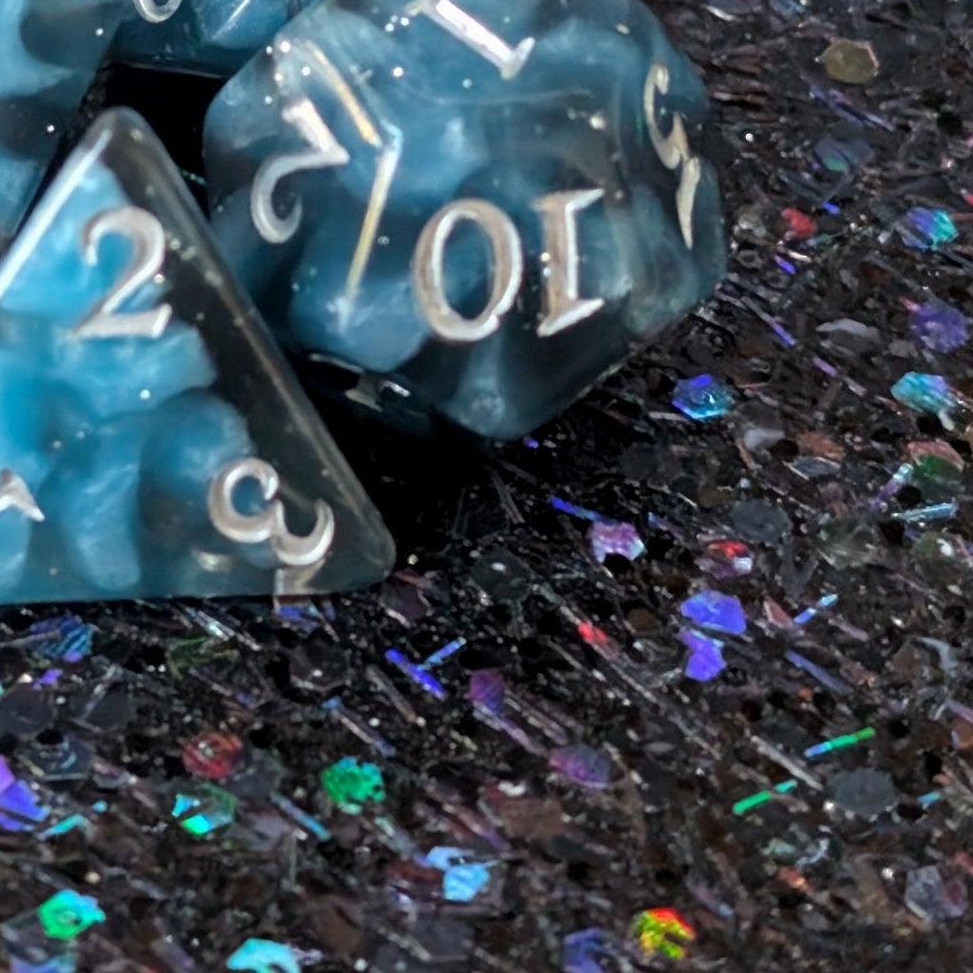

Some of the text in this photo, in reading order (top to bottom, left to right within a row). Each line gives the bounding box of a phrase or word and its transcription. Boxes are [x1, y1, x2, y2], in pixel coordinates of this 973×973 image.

[250, 97, 350, 244] 2
[73, 205, 173, 339] 2
[411, 188, 605, 341] 10
[208, 456, 335, 566] 3
